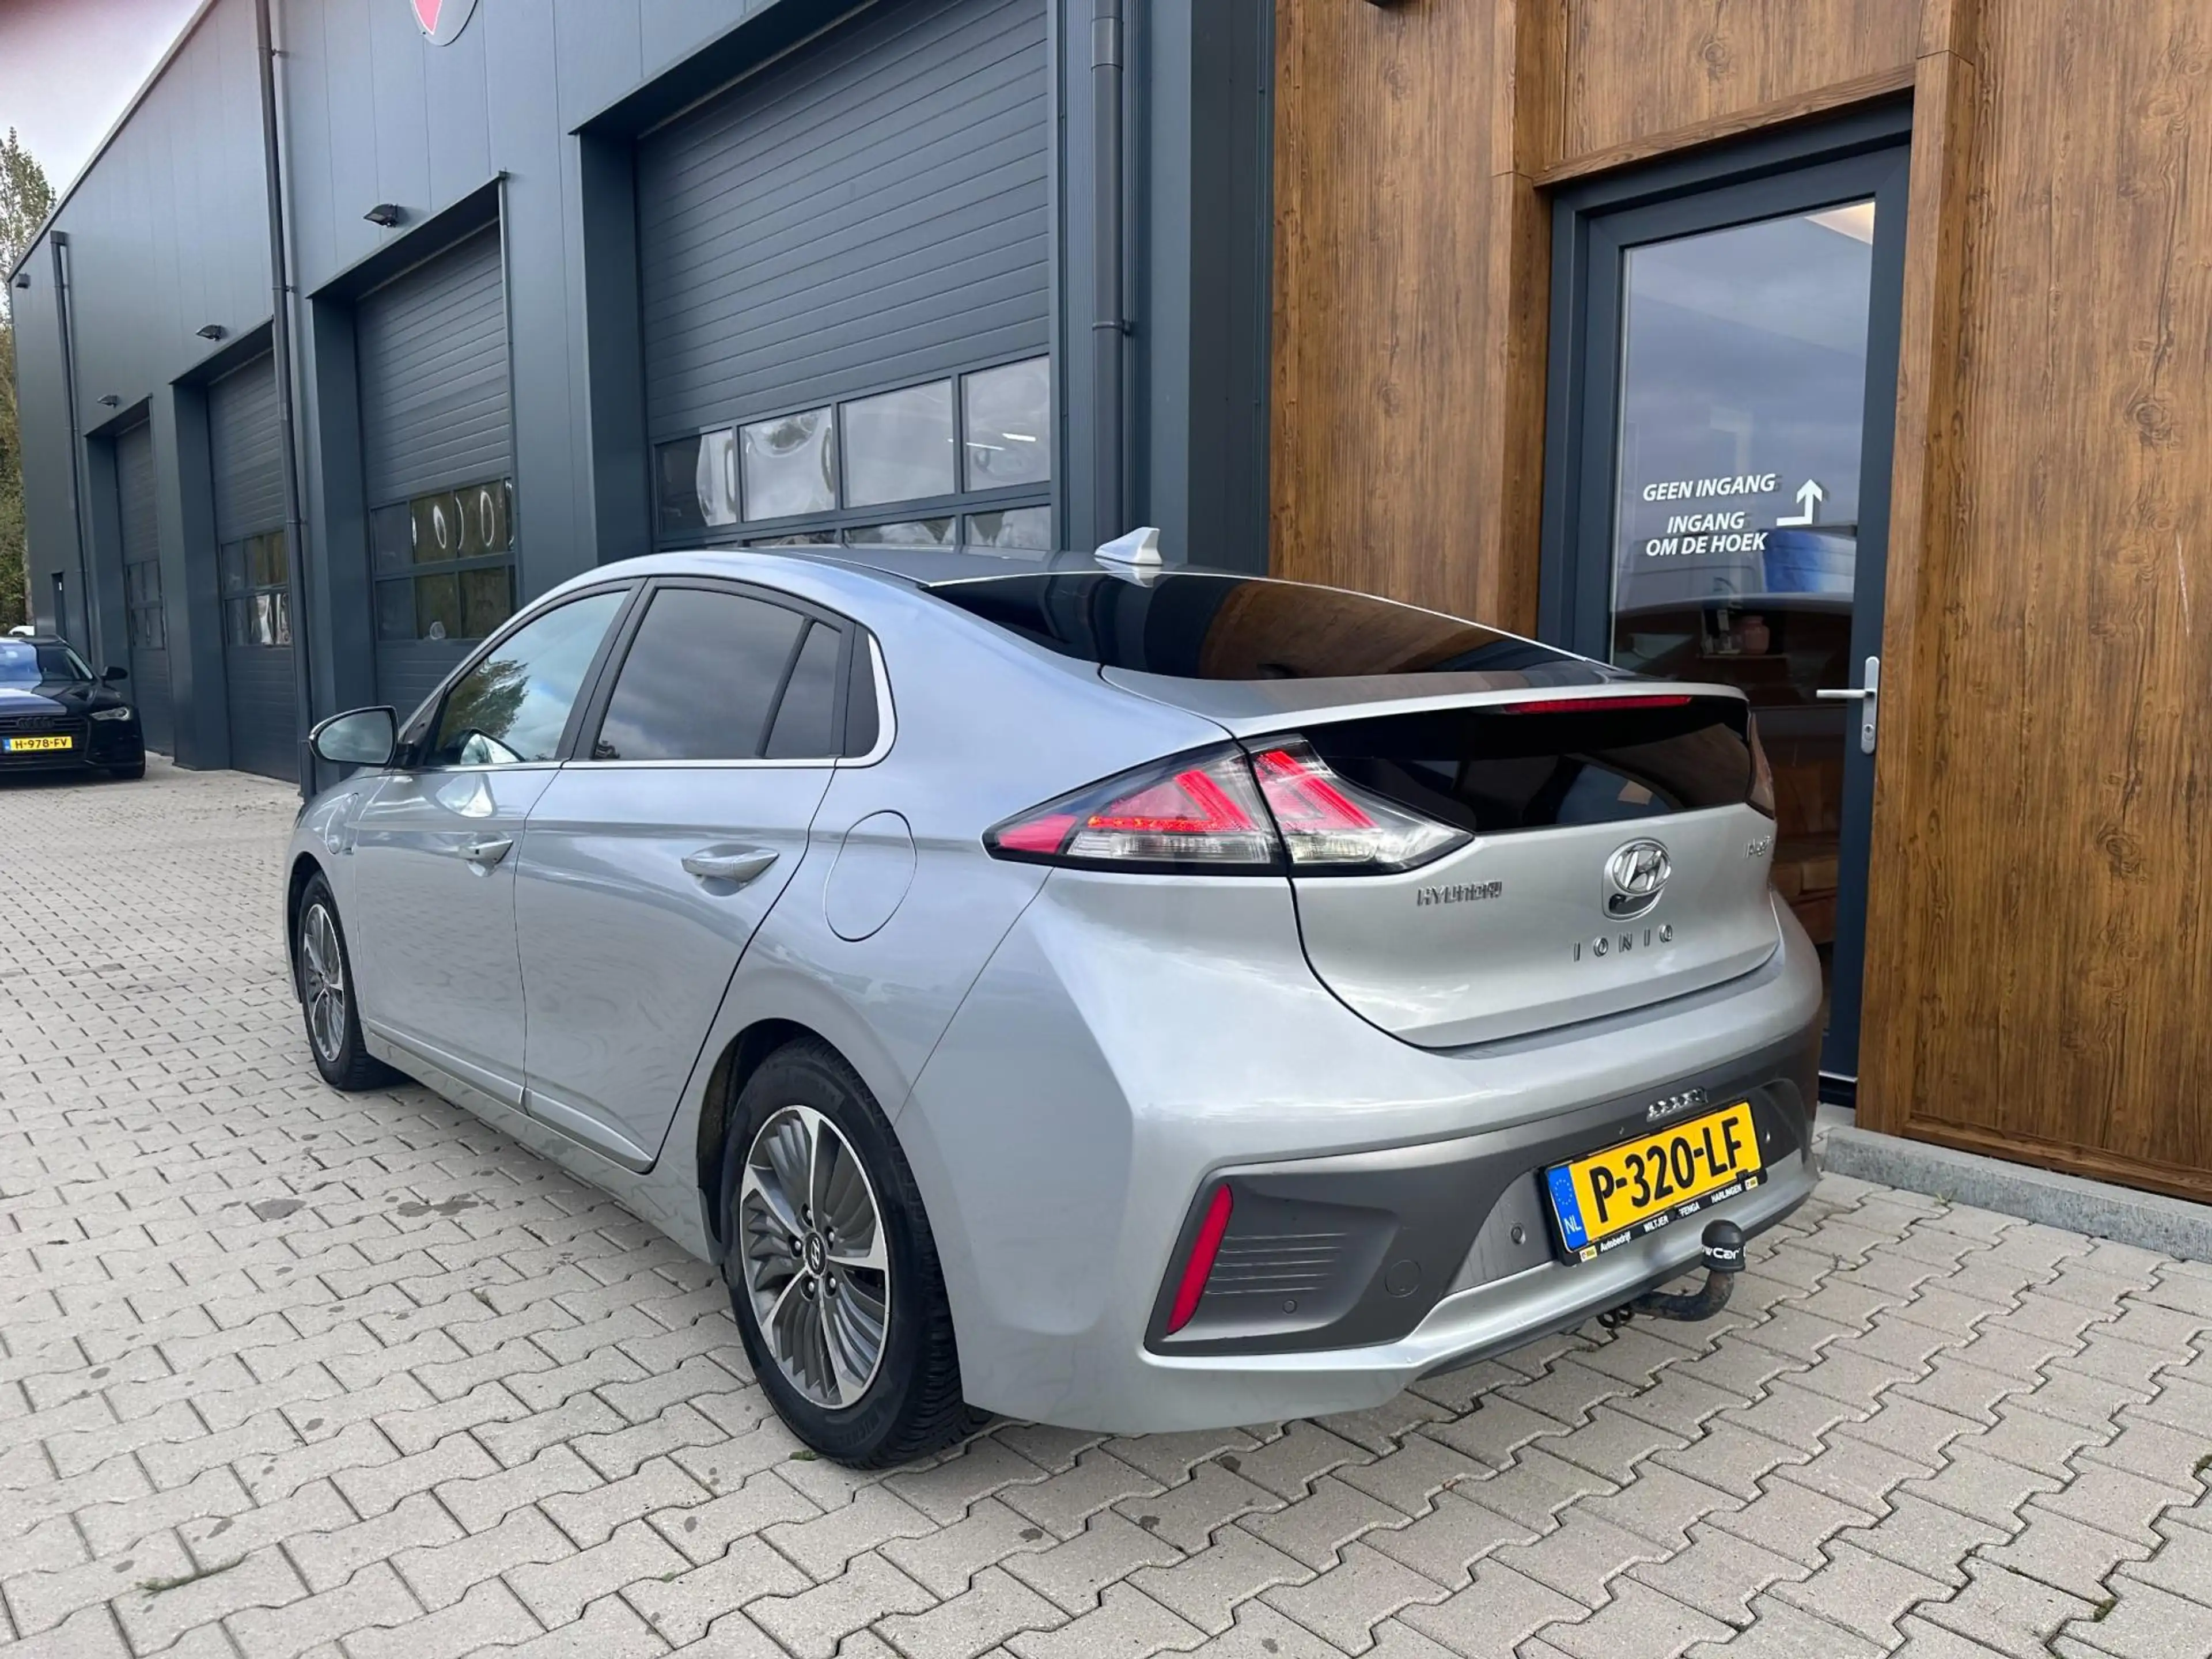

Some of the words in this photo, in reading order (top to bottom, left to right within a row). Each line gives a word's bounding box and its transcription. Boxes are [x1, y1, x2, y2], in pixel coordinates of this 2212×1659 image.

[1643, 480, 1692, 501] GEEN
[1695, 474, 1775, 498] INGANG
[1667, 512, 1745, 533] INGANG
[1646, 538, 1677, 556] OM
[1681, 536, 1706, 554] DE
[1710, 532, 1768, 552] HOEK
[15, 738, 67, 749] H-978-FV
[1589, 1116, 1741, 1223] P-320-LF
[1711, 1184, 1742, 1203] HARLINGEN
[1563, 1214, 1582, 1234] NL
